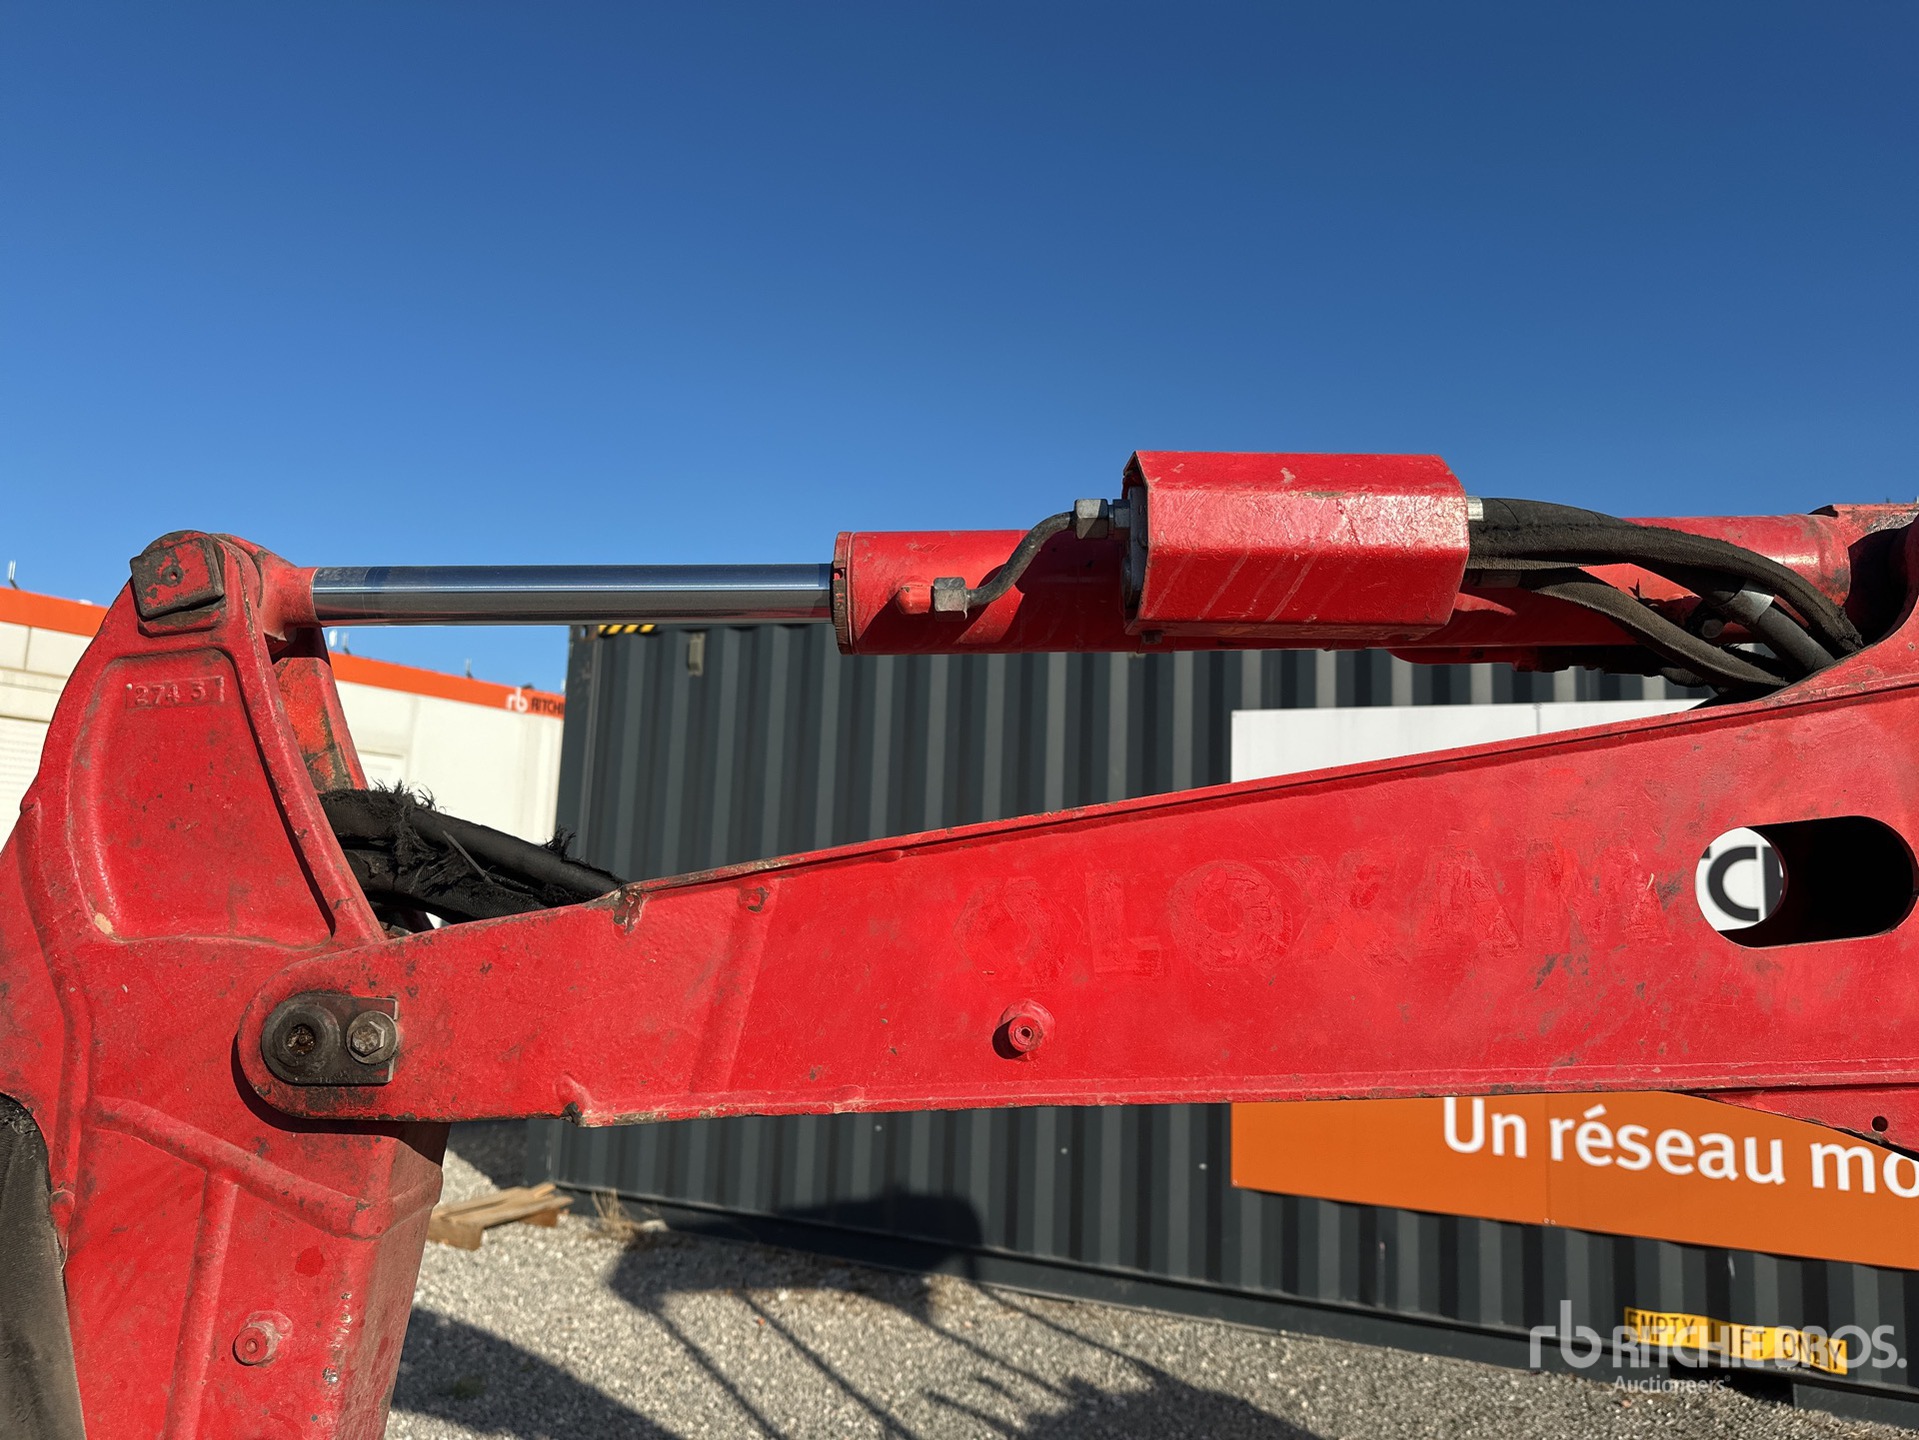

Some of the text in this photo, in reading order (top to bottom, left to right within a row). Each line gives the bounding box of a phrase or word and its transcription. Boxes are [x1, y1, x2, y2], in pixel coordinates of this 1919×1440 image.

[1444, 1096, 1527, 1158] Un
[1549, 1104, 1786, 1185] réseau
[1626, 1310, 1843, 1371] EMPTY LIFT ONLY
